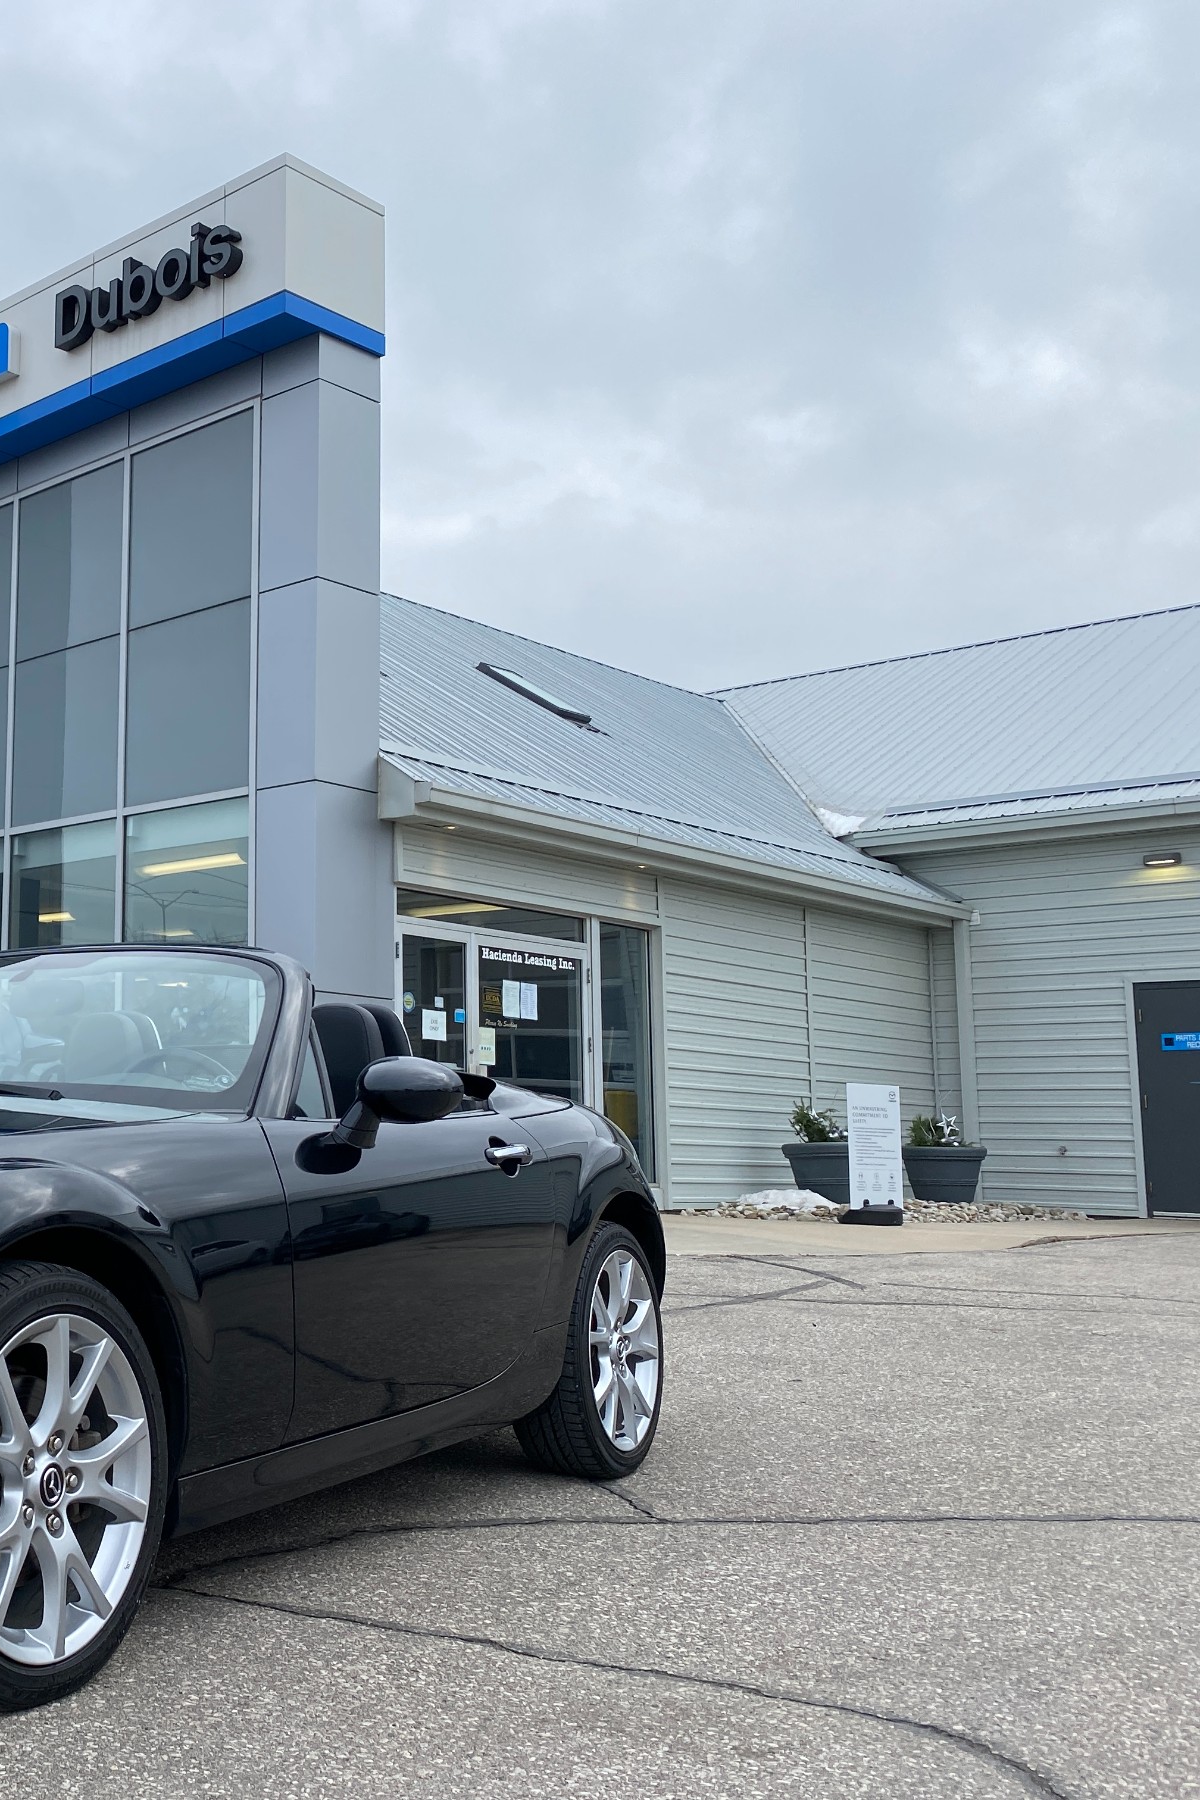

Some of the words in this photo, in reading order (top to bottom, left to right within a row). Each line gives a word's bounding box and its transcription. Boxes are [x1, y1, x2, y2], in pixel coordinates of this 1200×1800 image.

[54, 222, 243, 351] Dubois
[481, 947, 523, 964] Hacienda
[524, 953, 557, 971] Leasing
[558, 957, 575, 970] Inc.
